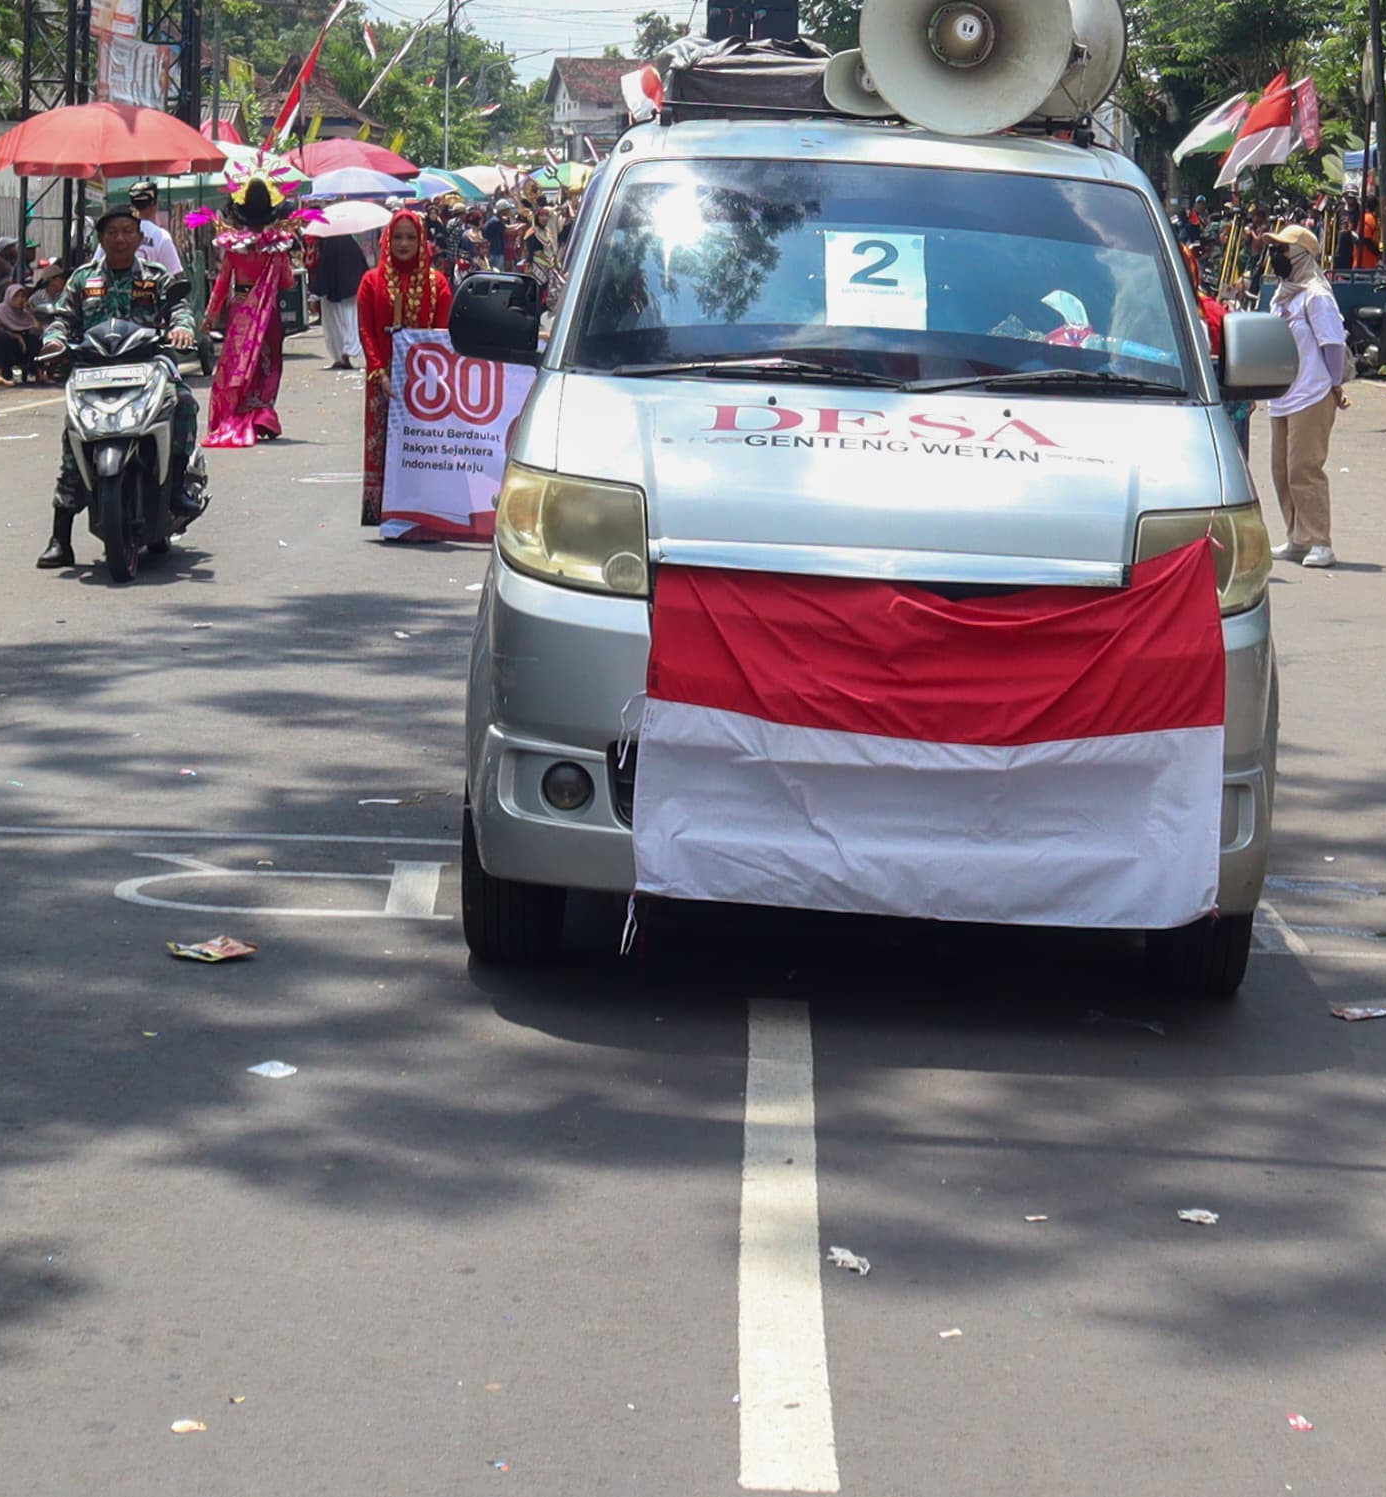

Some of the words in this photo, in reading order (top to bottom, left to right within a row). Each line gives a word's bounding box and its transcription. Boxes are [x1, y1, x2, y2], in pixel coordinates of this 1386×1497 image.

[849, 239, 899, 287] 2
[404, 341, 505, 426] 80
[403, 426, 444, 439] Bersatu
[447, 428, 500, 443] Berdaulat
[700, 403, 1067, 448] DESA
[402, 442, 438, 456] Rakyat
[441, 444, 494, 458] Sejahtera
[744, 434, 910, 454] GENTENG
[920, 442, 1041, 464] WETAN
[401, 459, 453, 471] Indonesia
[456, 461, 483, 474] Maju
